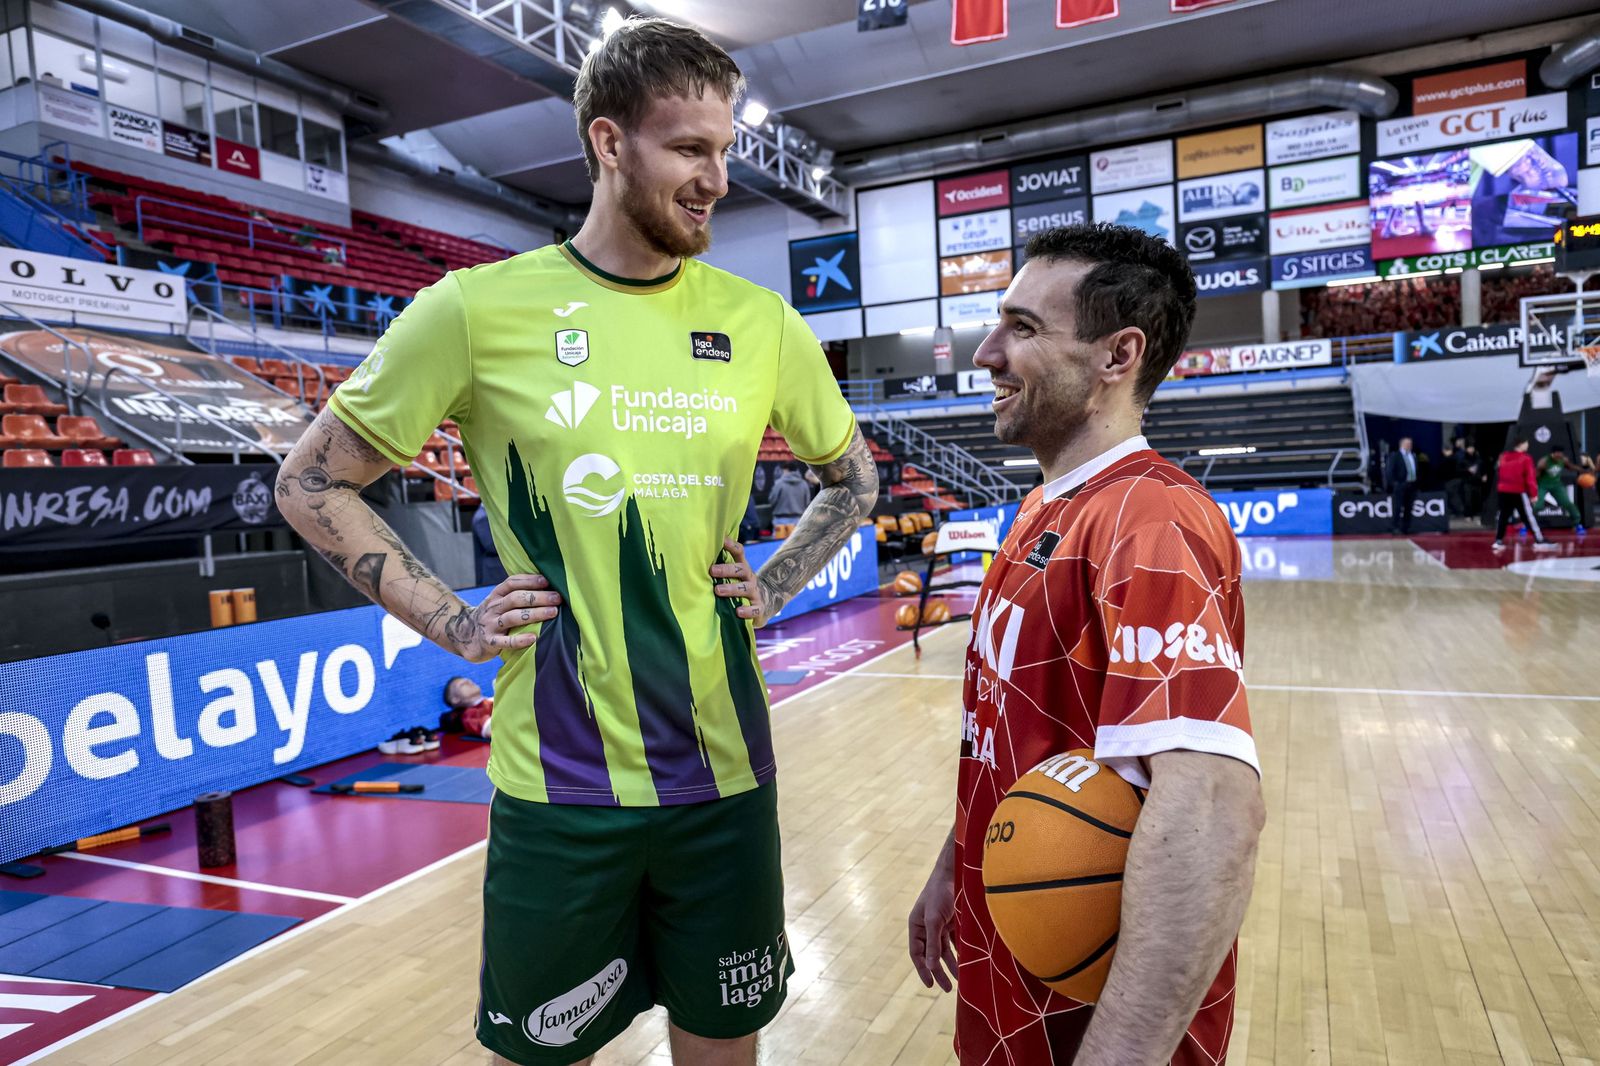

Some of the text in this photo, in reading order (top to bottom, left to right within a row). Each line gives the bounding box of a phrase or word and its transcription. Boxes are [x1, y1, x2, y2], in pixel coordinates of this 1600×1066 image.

[1416, 77, 1525, 103] www.gctplus.com
[1440, 107, 1547, 136] GCT plus
[1398, 133, 1420, 146] ETT
[1016, 166, 1081, 192] JOVIAT
[956, 184, 1003, 201] Occident
[1017, 210, 1084, 233] sensus
[962, 230, 988, 240] GRUP
[1301, 250, 1365, 274] SITGES
[1416, 253, 1466, 272] COTS
[1480, 243, 1554, 264] CLARET
[1194, 268, 1260, 291] UJOLS
[12, 289, 131, 312] MOTORCAT PREMIUM
[695, 338, 712, 349] liga
[1445, 324, 1565, 353] CaixaBank
[696, 347, 729, 359] endesa
[1258, 343, 1322, 364] AIGNEP
[611, 384, 737, 414] Fundación
[612, 408, 707, 439] Unicaja
[633, 473, 724, 488] COSTA DEL SOL
[633, 485, 688, 499] MÁLAGA
[0, 485, 212, 531] NRESA.COM
[236, 493, 270, 506] BAXI
[1339, 495, 1445, 519] endsa
[948, 530, 986, 541] Wilson
[718, 947, 758, 967] sabor
[719, 945, 775, 986] a má
[535, 963, 624, 1038] famadesa
[720, 974, 775, 1008] laga
